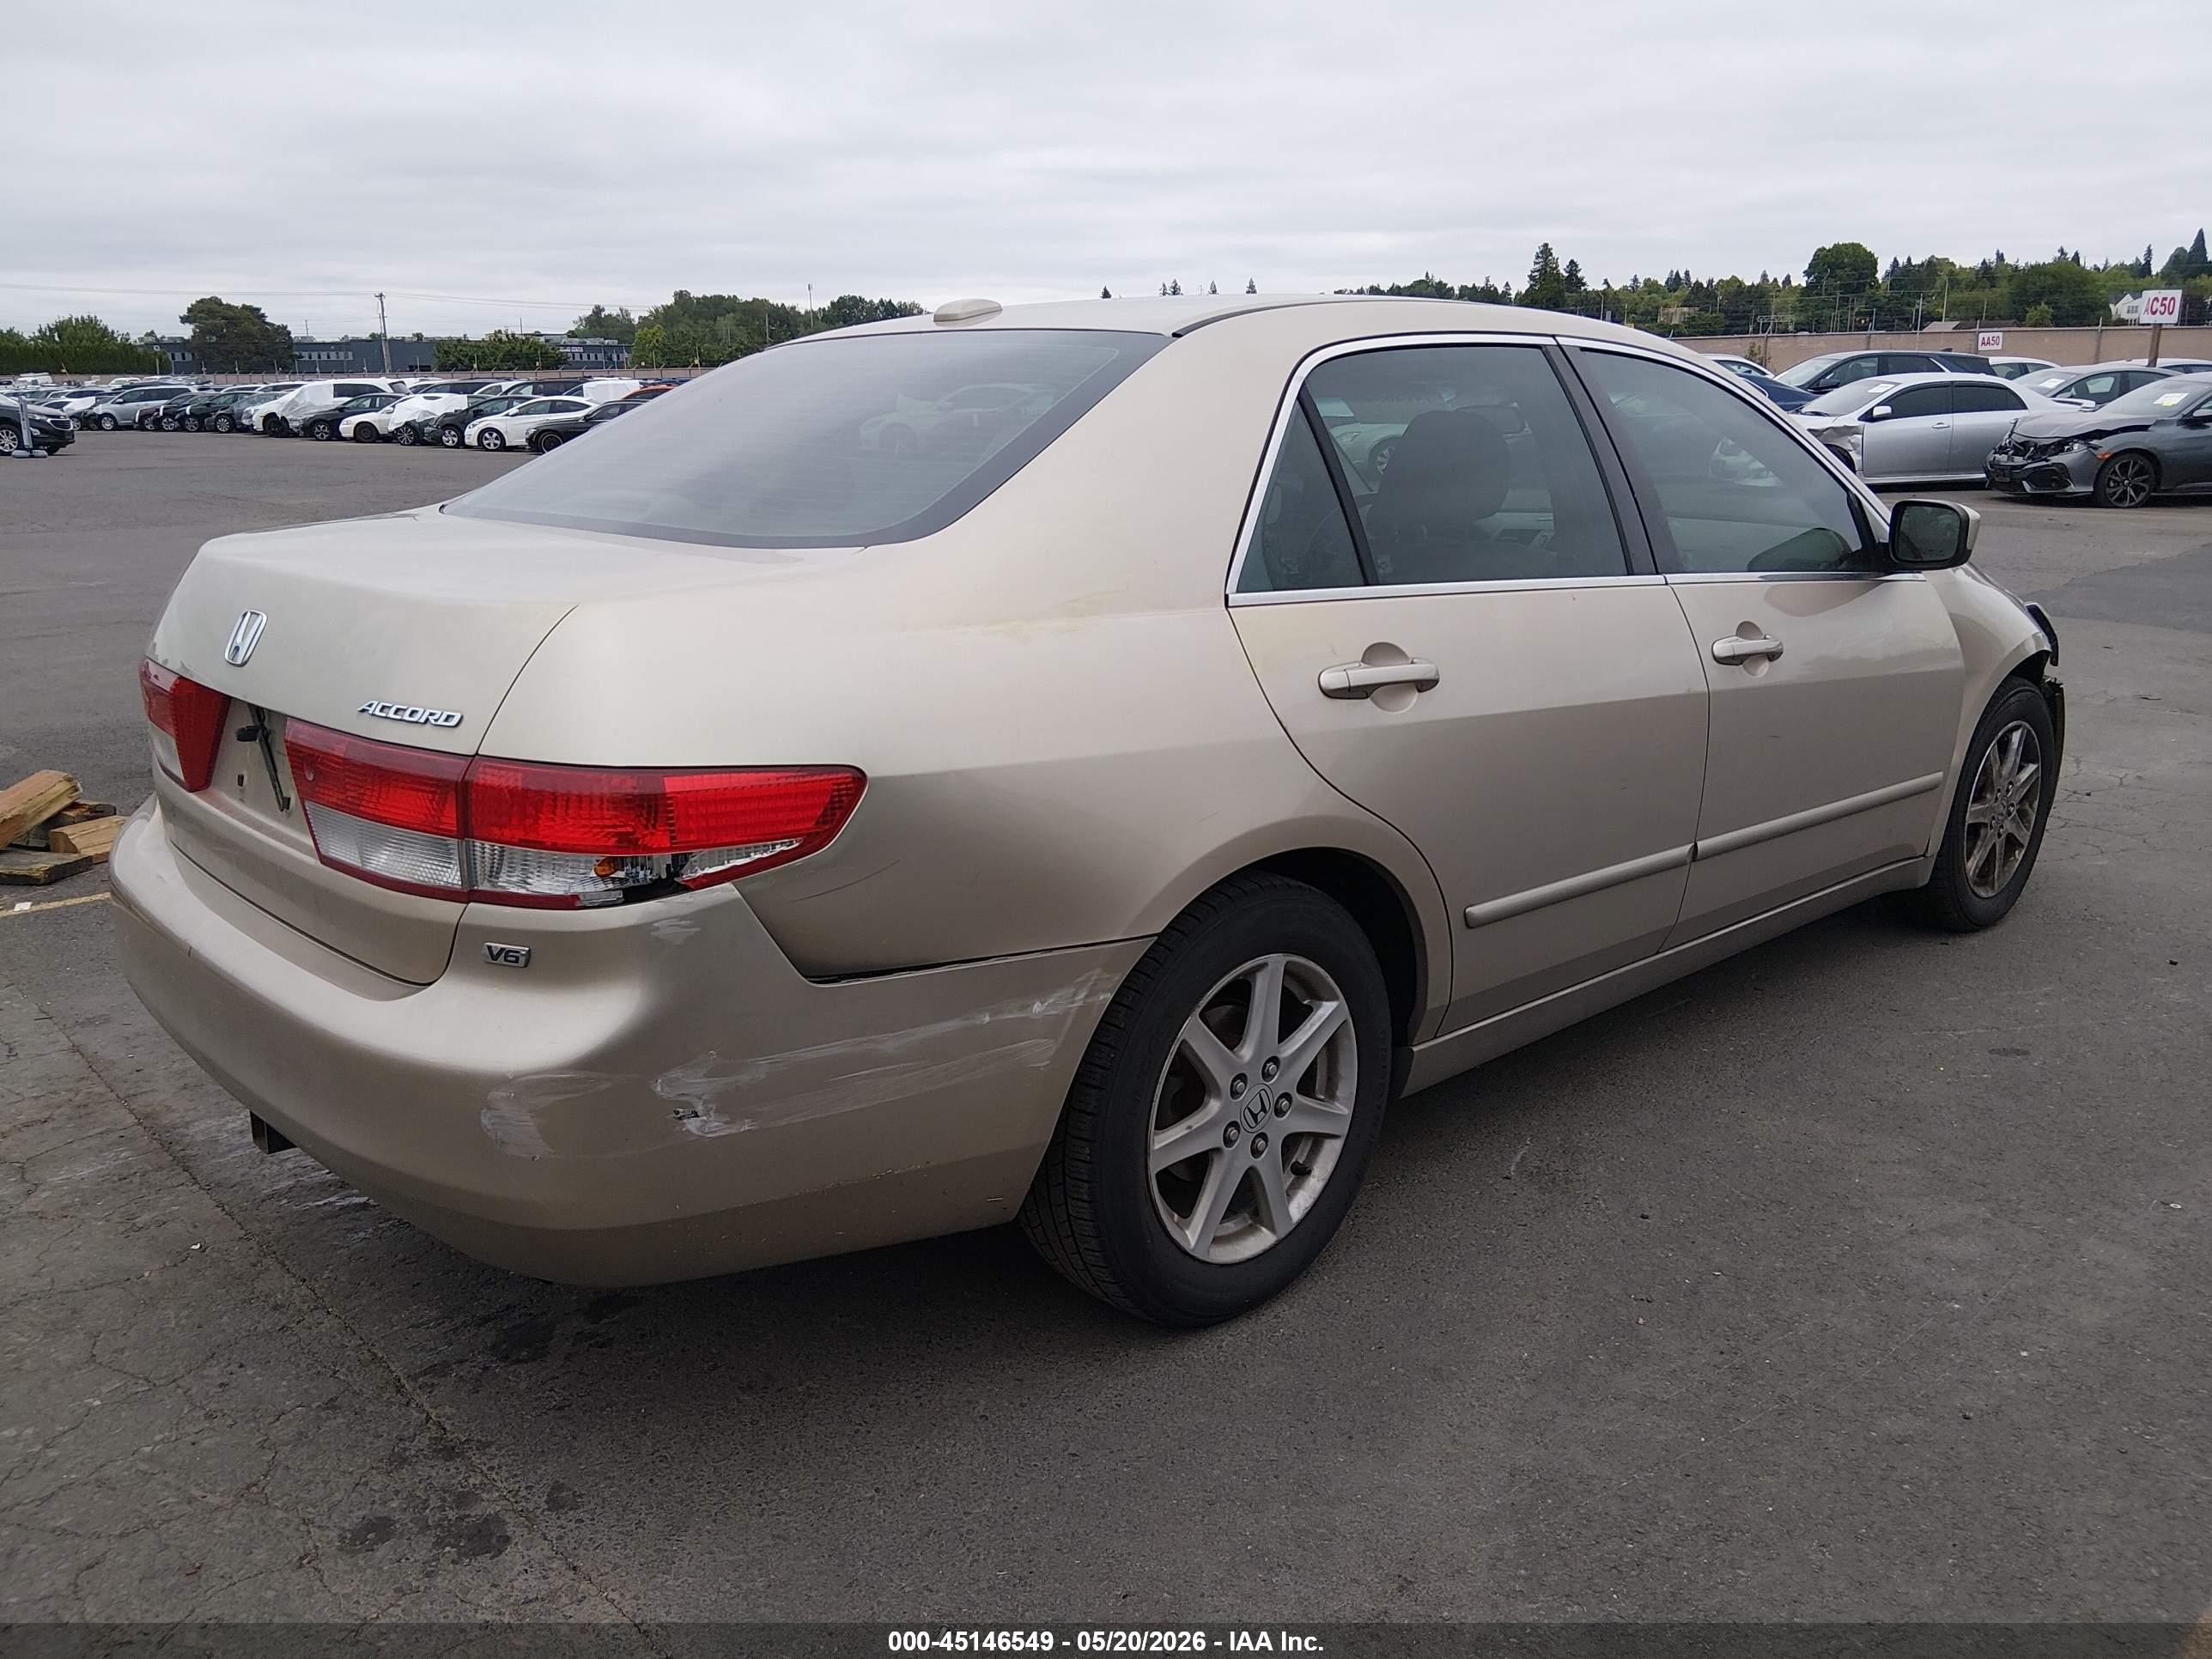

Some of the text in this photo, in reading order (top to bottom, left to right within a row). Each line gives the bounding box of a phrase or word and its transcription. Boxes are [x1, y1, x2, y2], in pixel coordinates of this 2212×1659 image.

[2143, 296, 2176, 316] AC50
[1980, 336, 2000, 346] AA50
[357, 700, 462, 727] ACCORD
[486, 945, 520, 963] V6
